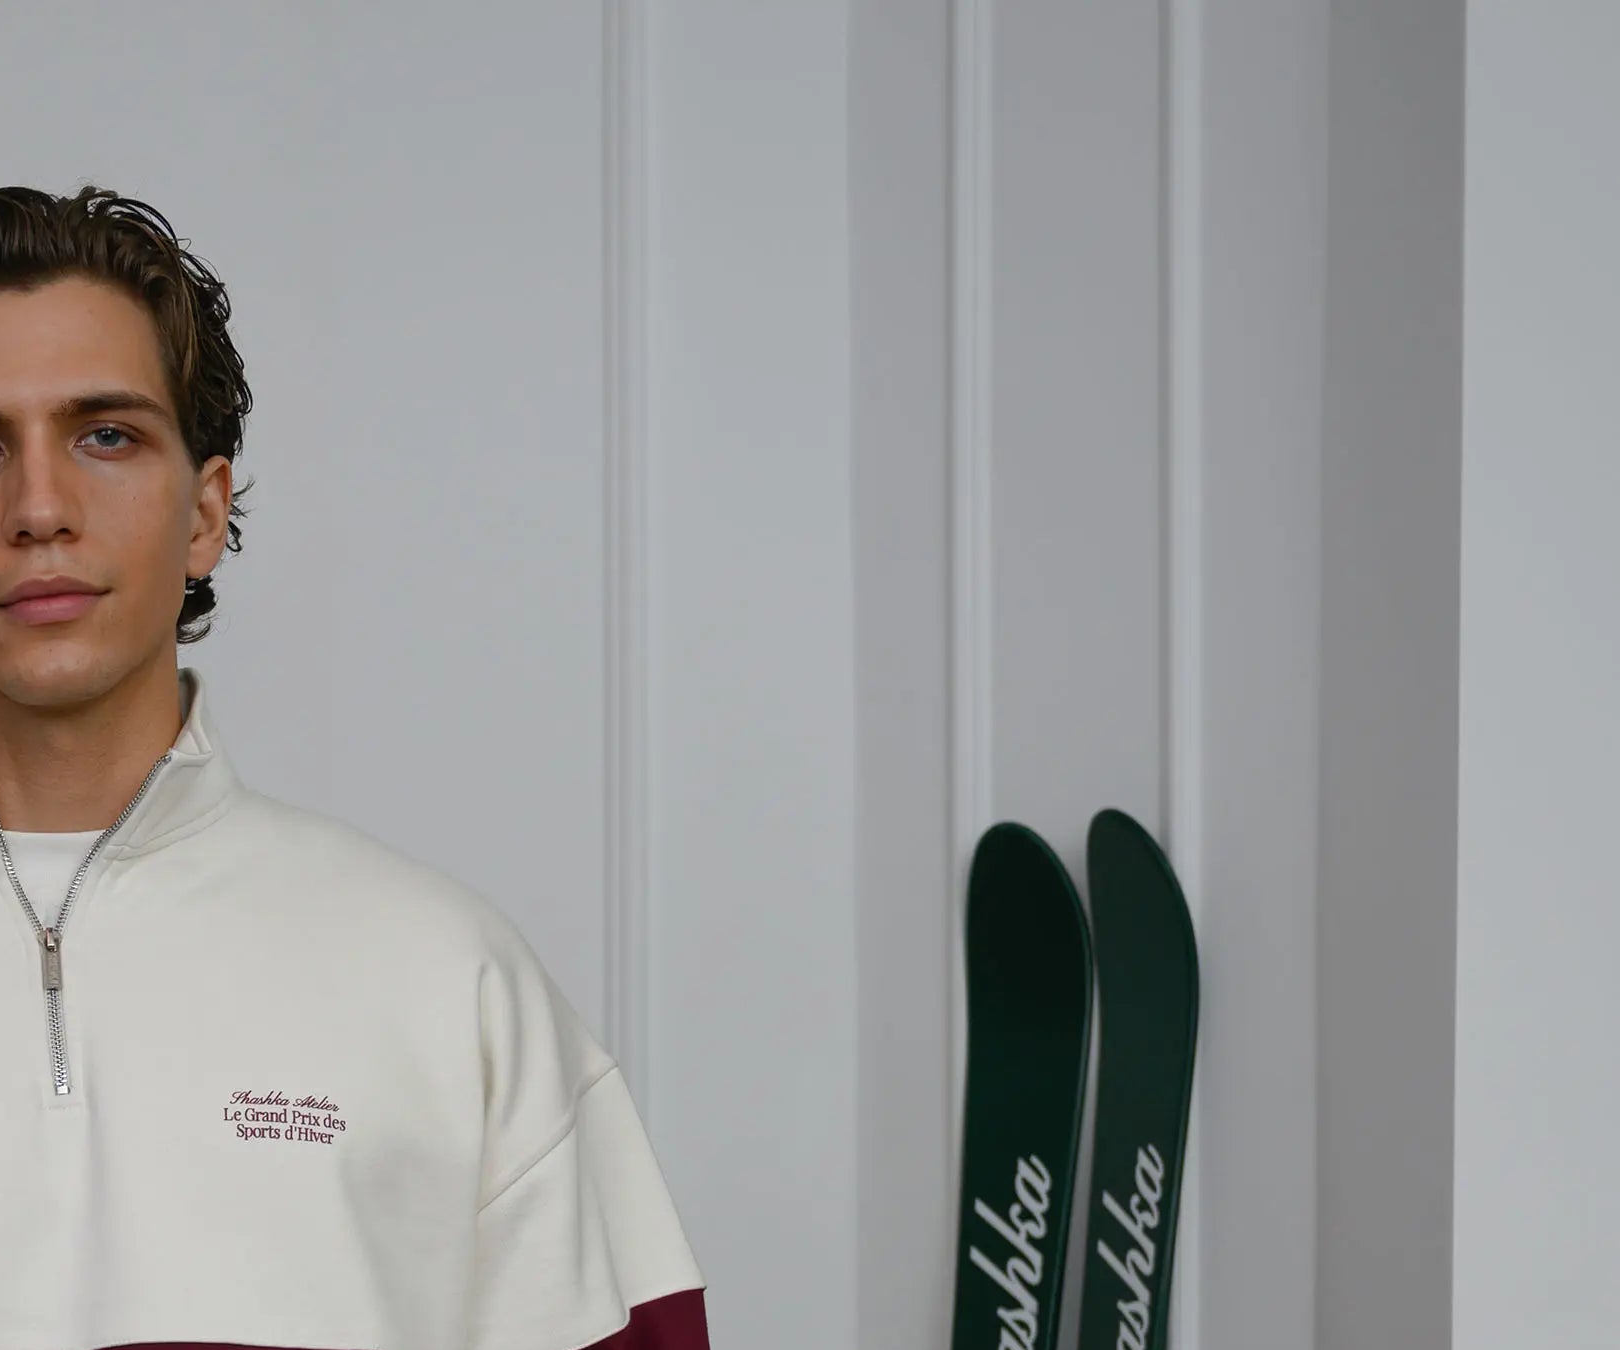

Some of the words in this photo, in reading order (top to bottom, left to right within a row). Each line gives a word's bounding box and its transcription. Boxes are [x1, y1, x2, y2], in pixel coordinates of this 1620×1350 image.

[230, 1090, 290, 1106] Shashka
[292, 1095, 340, 1112] Atelier
[223, 1107, 241, 1121] Le
[244, 1107, 288, 1123] Grand
[291, 1110, 321, 1127] Prix
[323, 1114, 347, 1132] des
[236, 1123, 281, 1140] Sports
[284, 1125, 335, 1145] d'Hiver
